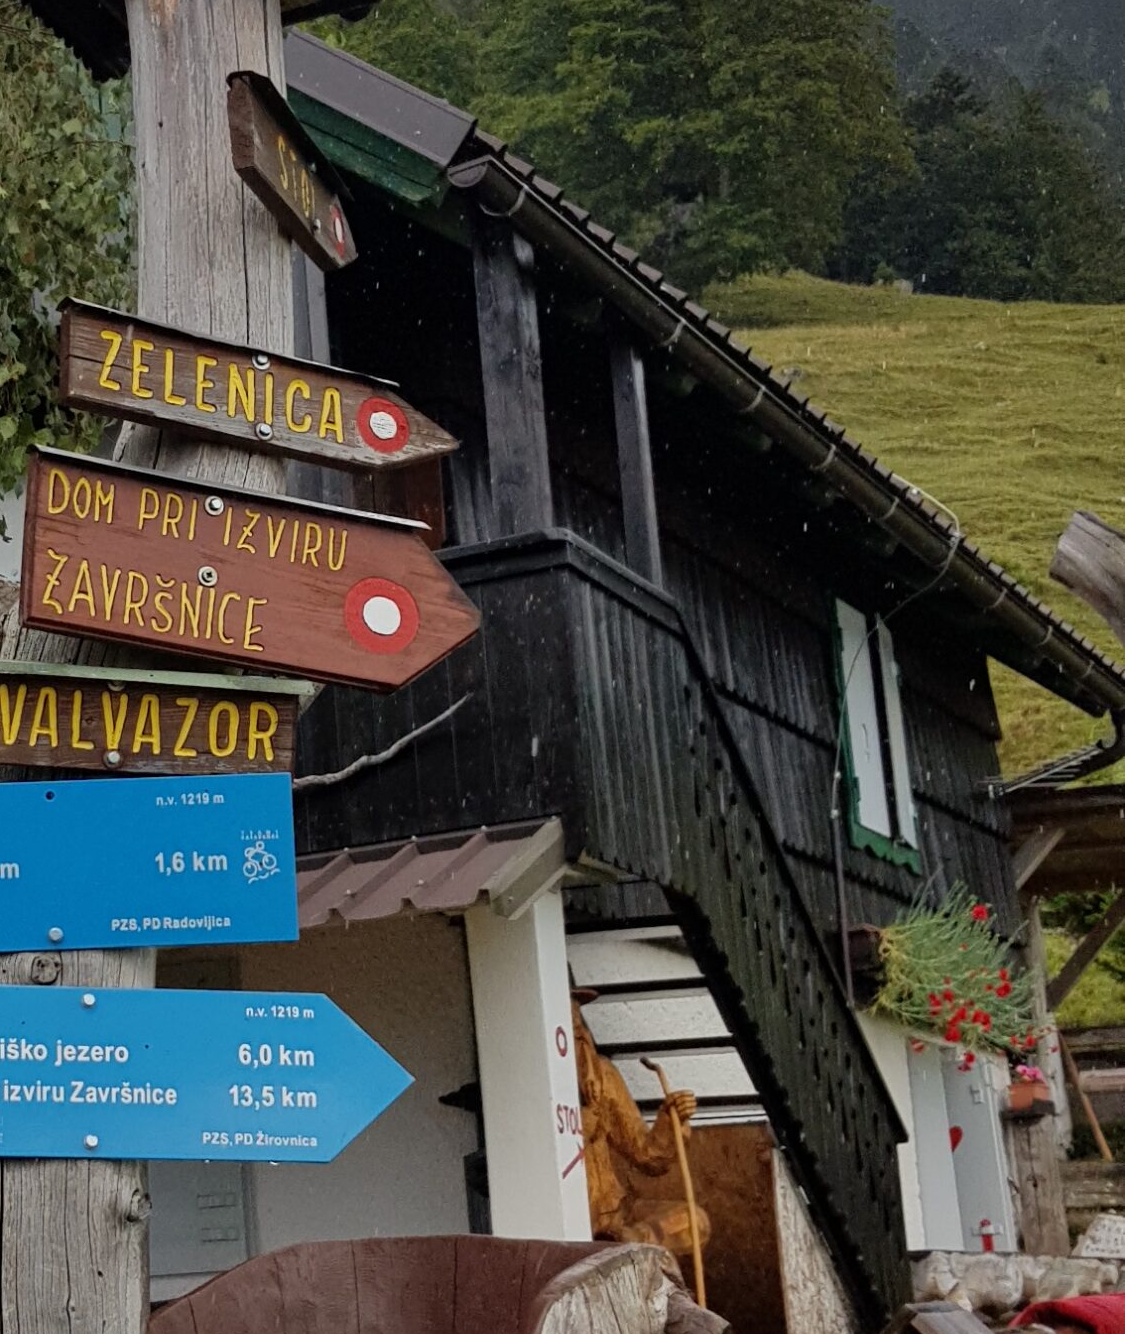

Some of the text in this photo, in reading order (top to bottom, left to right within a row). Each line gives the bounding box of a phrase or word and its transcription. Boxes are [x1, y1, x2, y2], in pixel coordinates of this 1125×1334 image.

[99, 330, 344, 443] ZELENICA
[47, 468, 348, 571] DOM PRI IZVIRU
[42, 548, 268, 652] ZAVRŠNICE
[0, 683, 279, 762] VALVAZOR
[156, 792, 224, 806] n.v. 1219 m
[155, 850, 228, 876] 1,6 km
[111, 915, 232, 932] PZS, PD Radovljica
[245, 1005, 315, 1019] n.v. 1219 m
[55, 1039, 129, 1067] jezero
[238, 1043, 315, 1069] 6,0 km
[3, 1079, 65, 1103] izviru
[70, 1081, 177, 1105] Završnice
[229, 1084, 317, 1111] 13,5 km
[202, 1130, 318, 1147] PZS, PD Žirovnica
